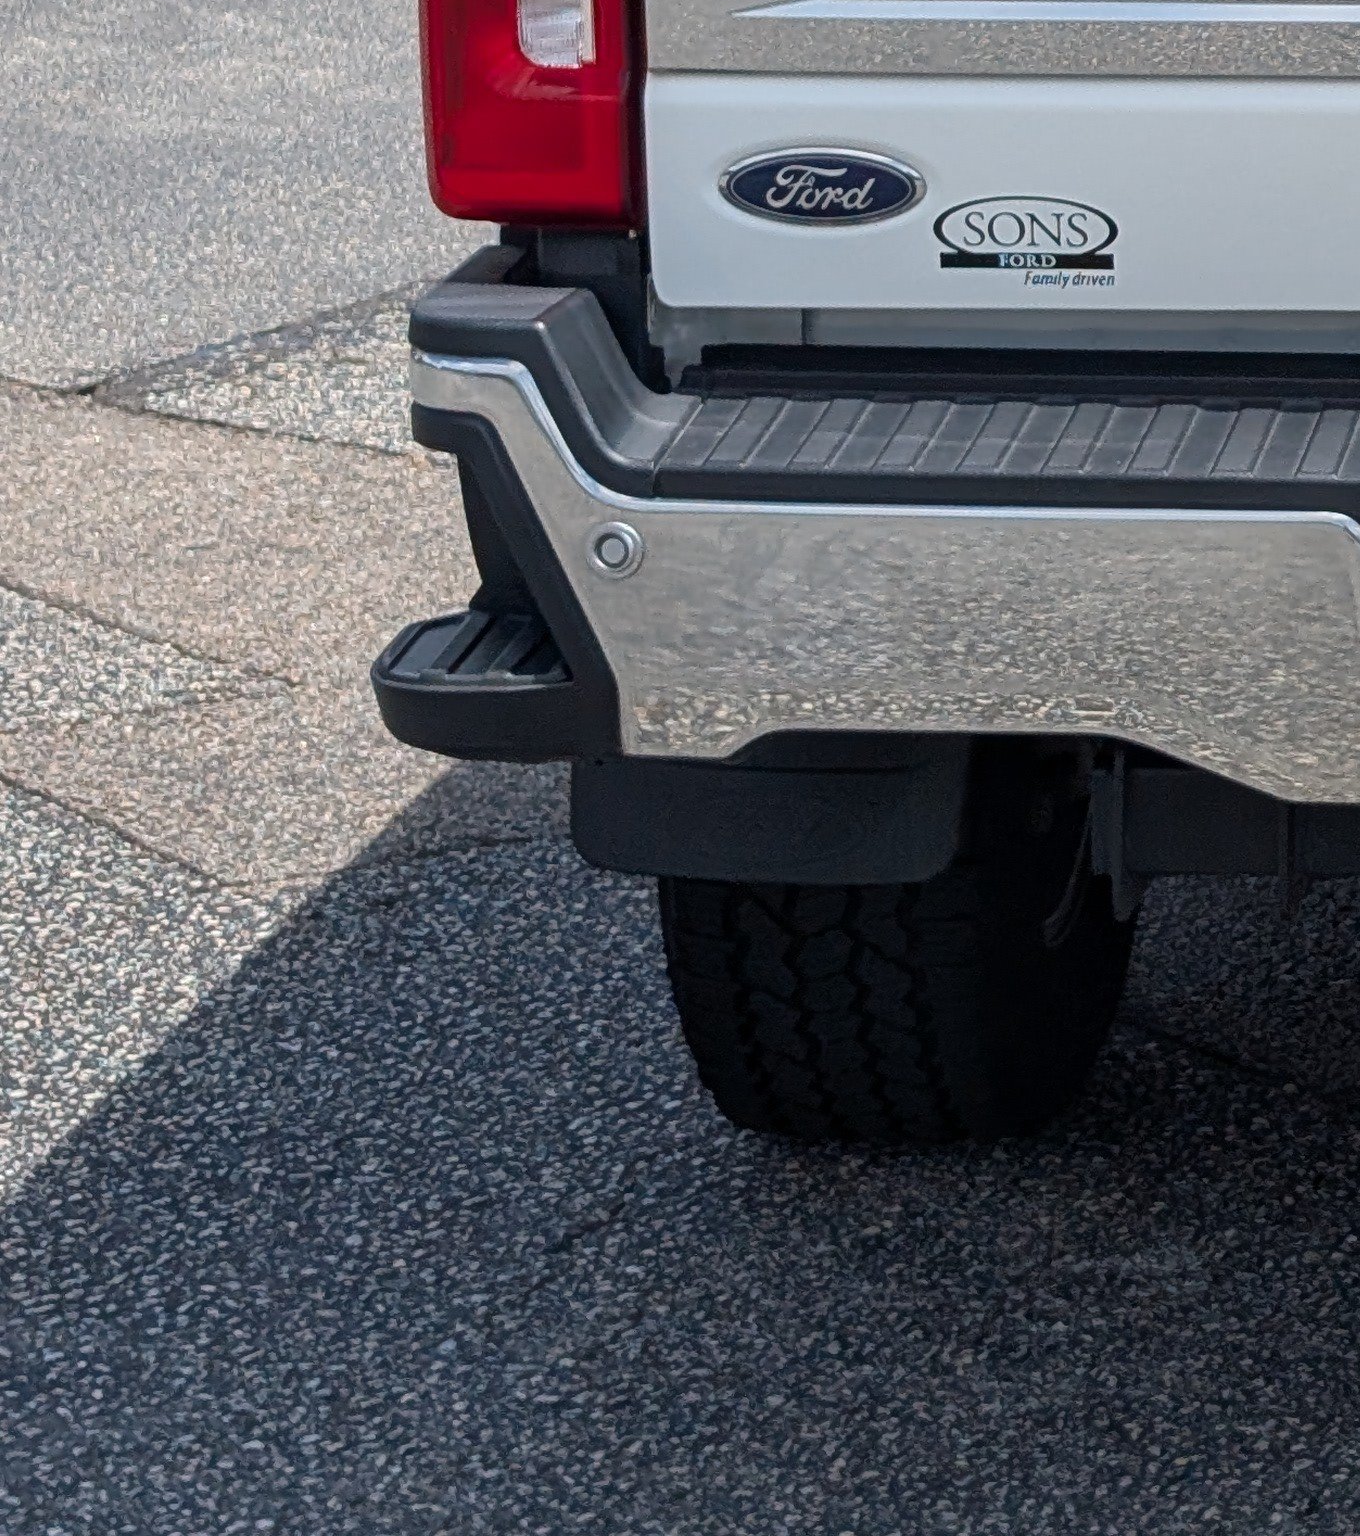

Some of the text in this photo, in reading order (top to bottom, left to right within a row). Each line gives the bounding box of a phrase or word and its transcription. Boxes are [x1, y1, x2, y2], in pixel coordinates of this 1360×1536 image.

[766, 164, 875, 211] Ford
[963, 211, 1089, 248] SONS
[999, 253, 1057, 269] FORD
[1023, 270, 1116, 290] Family driven
